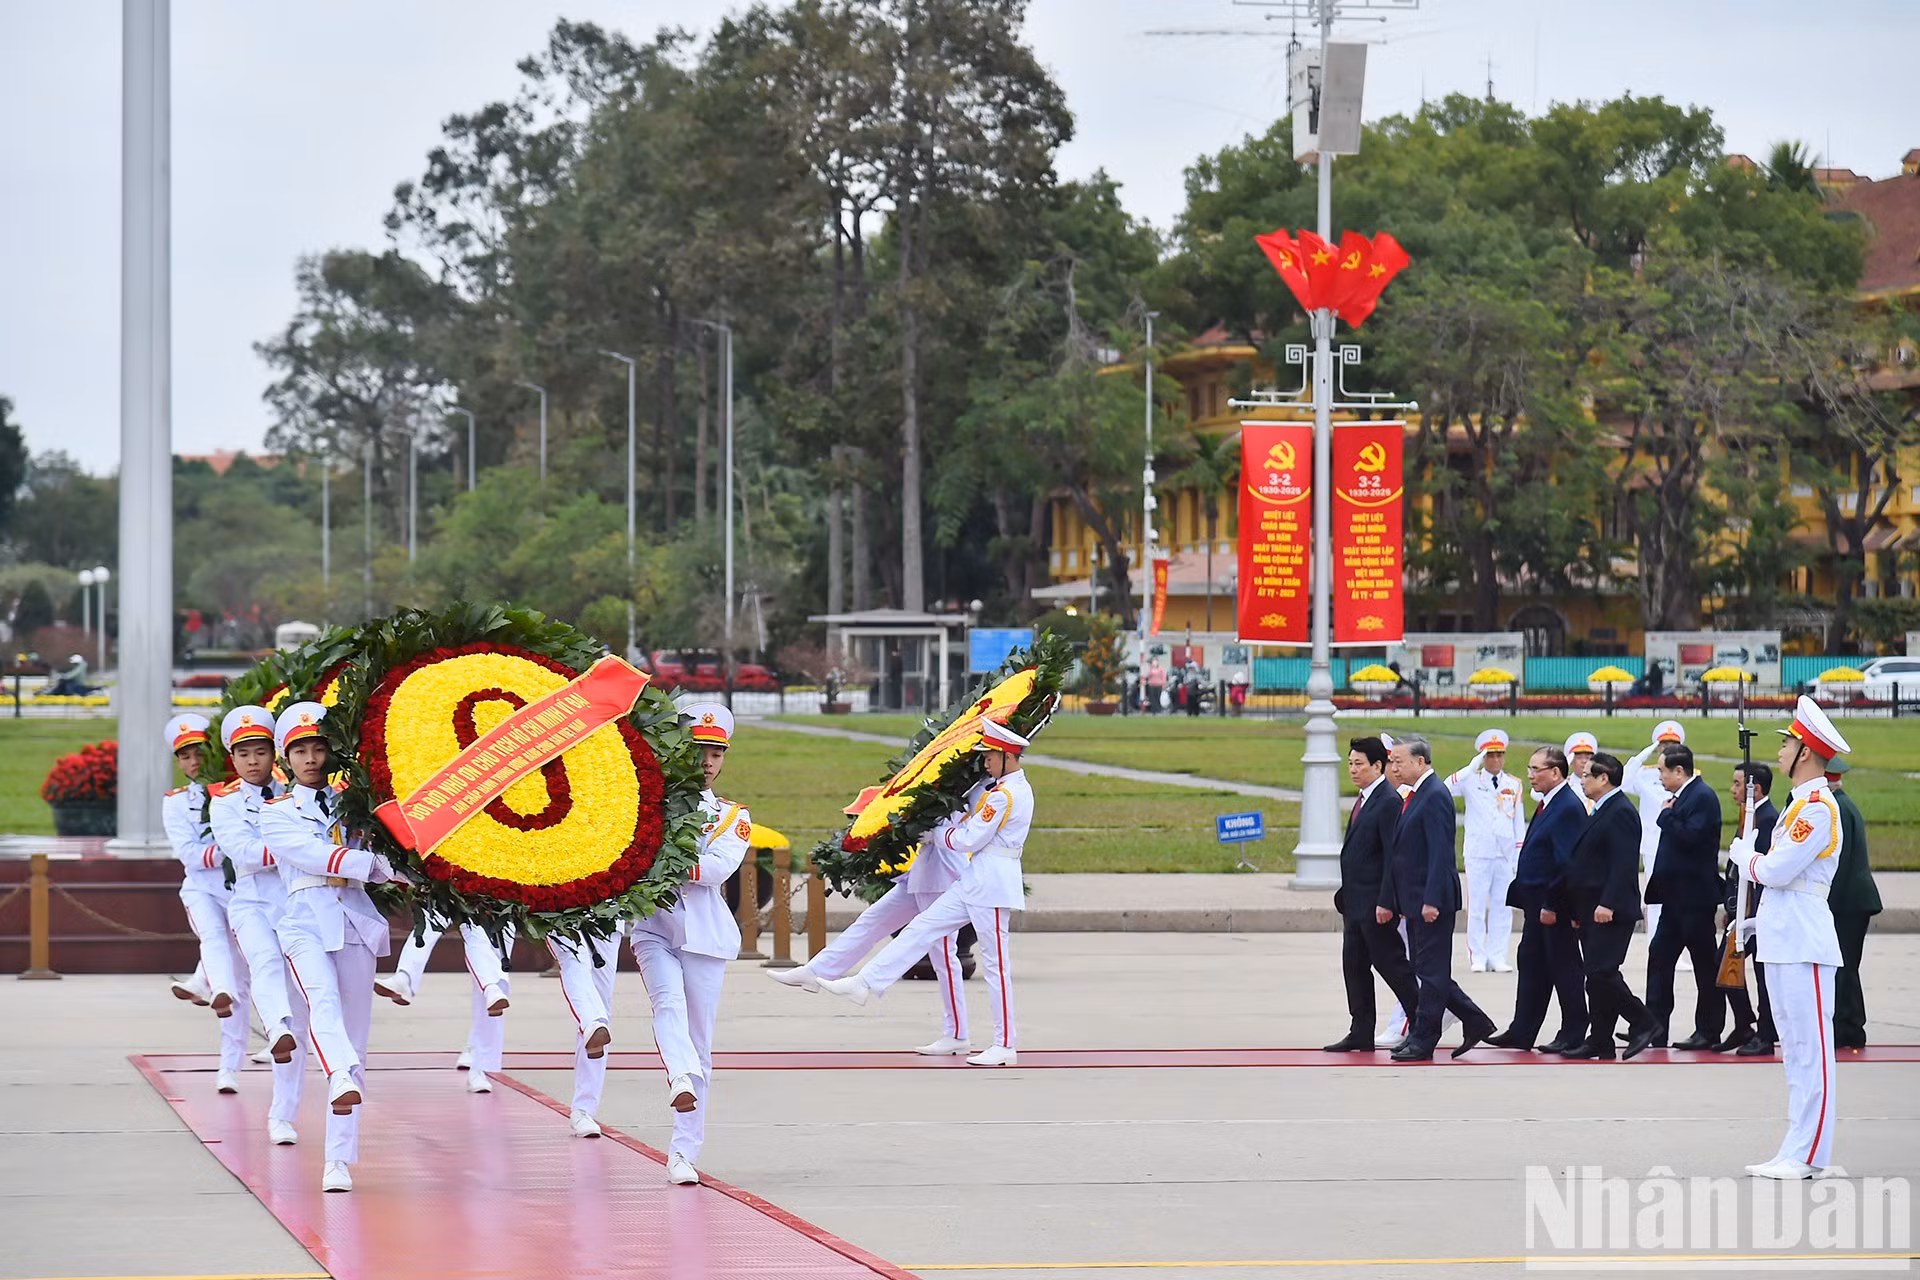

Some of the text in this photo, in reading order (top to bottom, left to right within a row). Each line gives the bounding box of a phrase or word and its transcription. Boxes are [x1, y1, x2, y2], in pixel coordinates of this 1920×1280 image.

[1269, 473, 1291, 486] 3-2
[1358, 475, 1381, 488] 3-2
[1258, 486, 1302, 495] 1930-2025
[1348, 488, 1391, 497] 1930-2025
[406, 692, 591, 821] ĐỜI ĐỜI NHỚ ƠN CHỦ TỊCH HỒ CHÍ MINH VĨ ĐẠI
[450, 800, 471, 815] BAN
[462, 790, 483, 806] CHẤP
[475, 778, 499, 795] HÀNH
[490, 766, 516, 783] TRUNG
[557, 726, 577, 740] VIỆT
[568, 717, 588, 733] NAM
